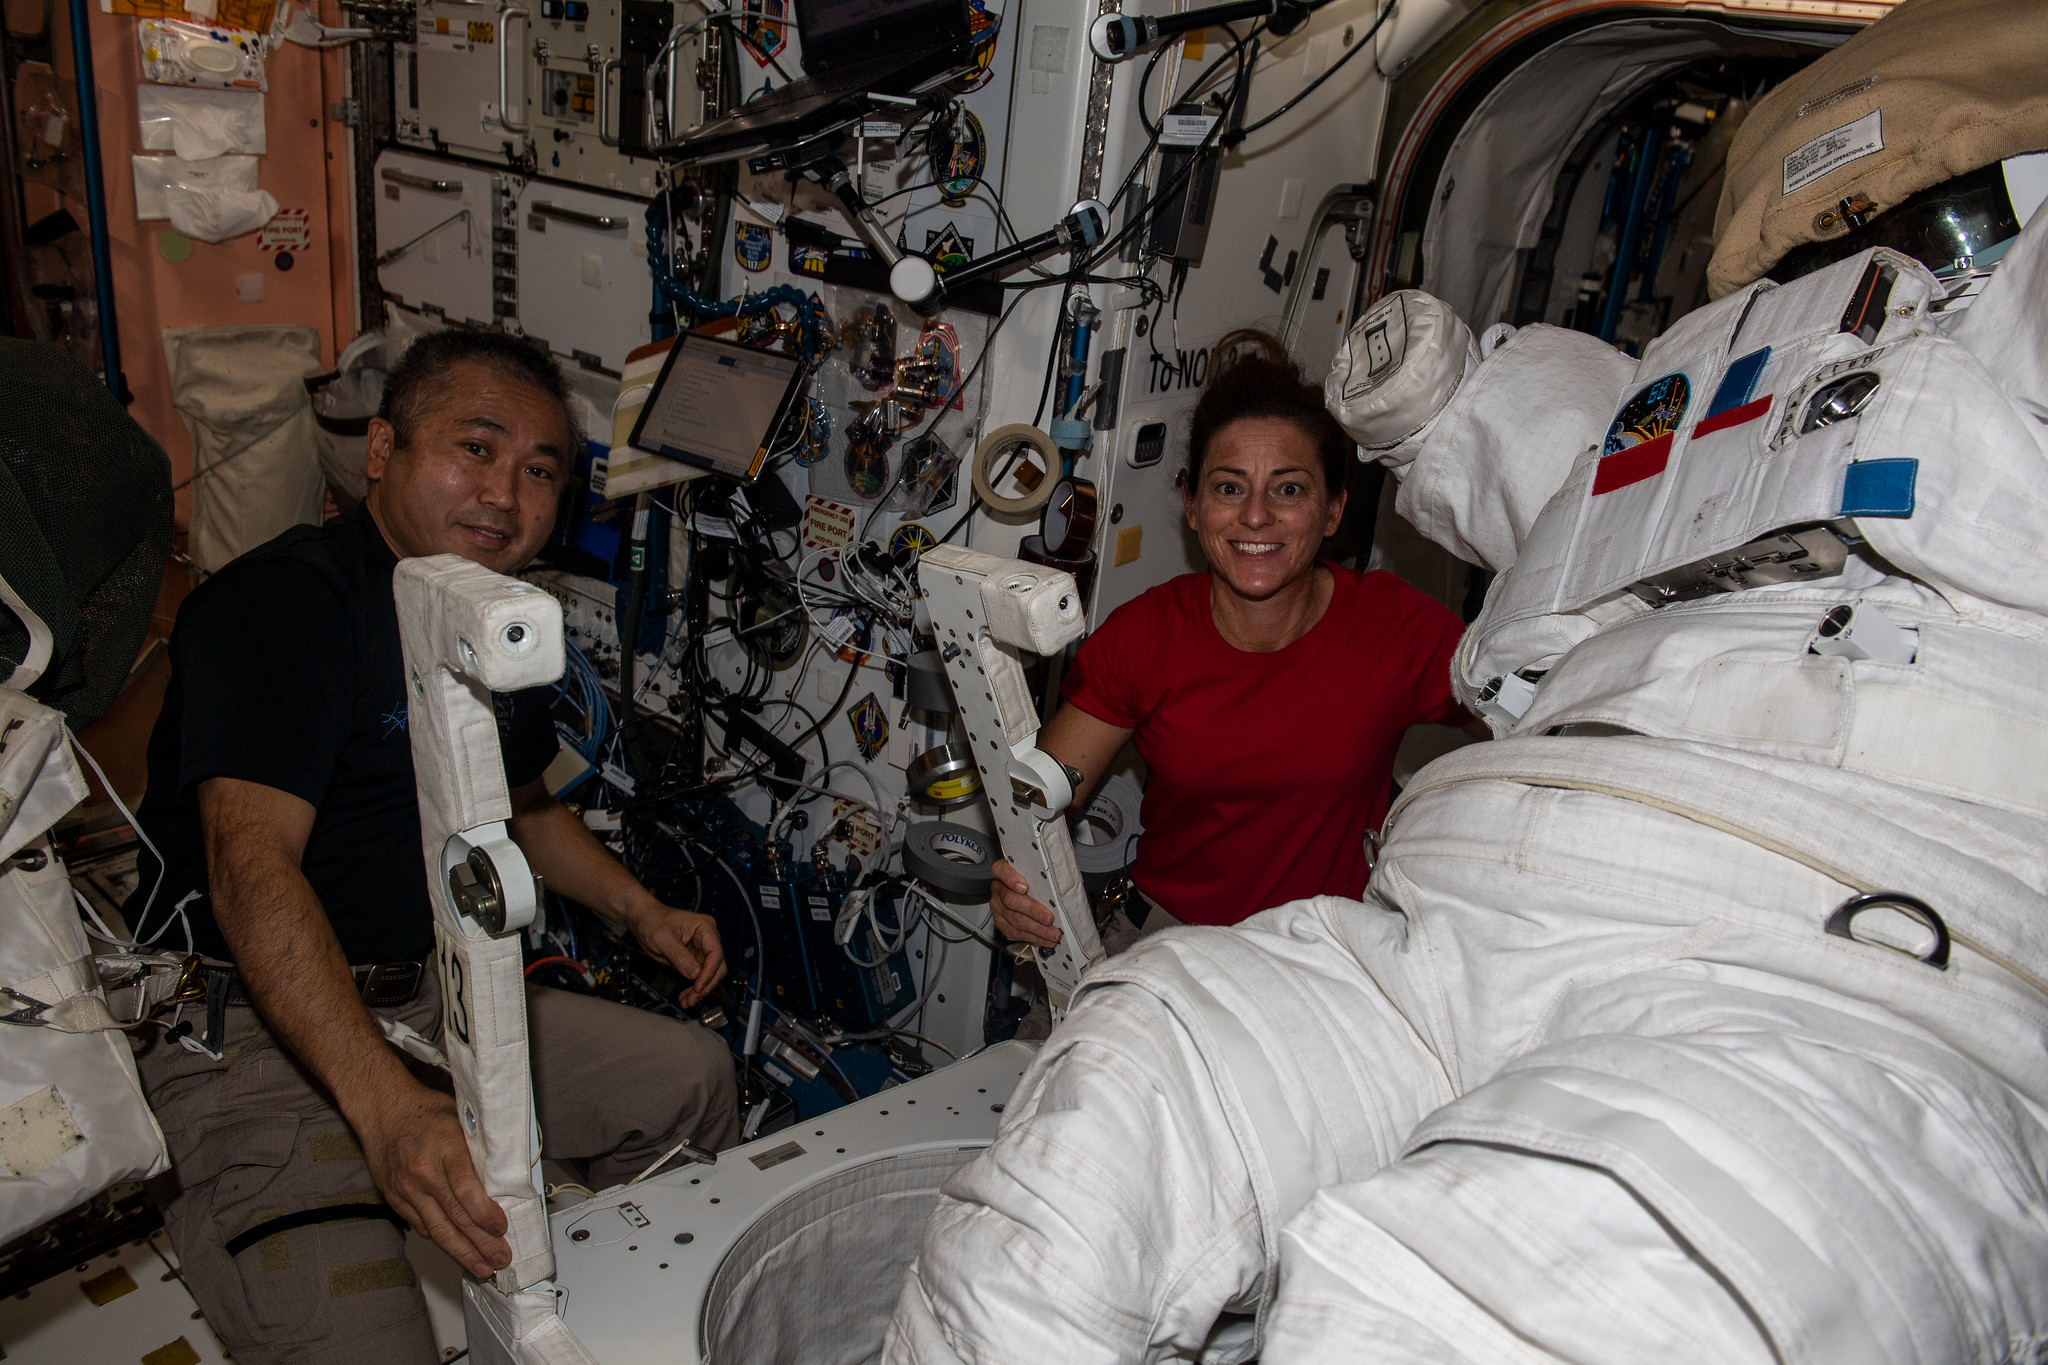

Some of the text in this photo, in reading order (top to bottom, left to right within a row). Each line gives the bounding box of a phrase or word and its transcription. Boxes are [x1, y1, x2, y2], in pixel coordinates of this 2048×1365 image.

[1786, 163, 1810, 179] CONTRACT
[1789, 176, 1805, 188] BOEING
[1806, 161, 1832, 178] AEROSPACE
[1833, 147, 1865, 163] OPERATIONS,
[264, 226, 302, 234] FIRE PORT
[748, 260, 758, 270] 117
[1647, 378, 1672, 404] 68
[810, 505, 848, 524] EMERGENCY USE
[931, 501, 949, 514] PATRICK
[810, 518, 848, 538] FIRE PORT
[856, 826, 875, 840] PORT
